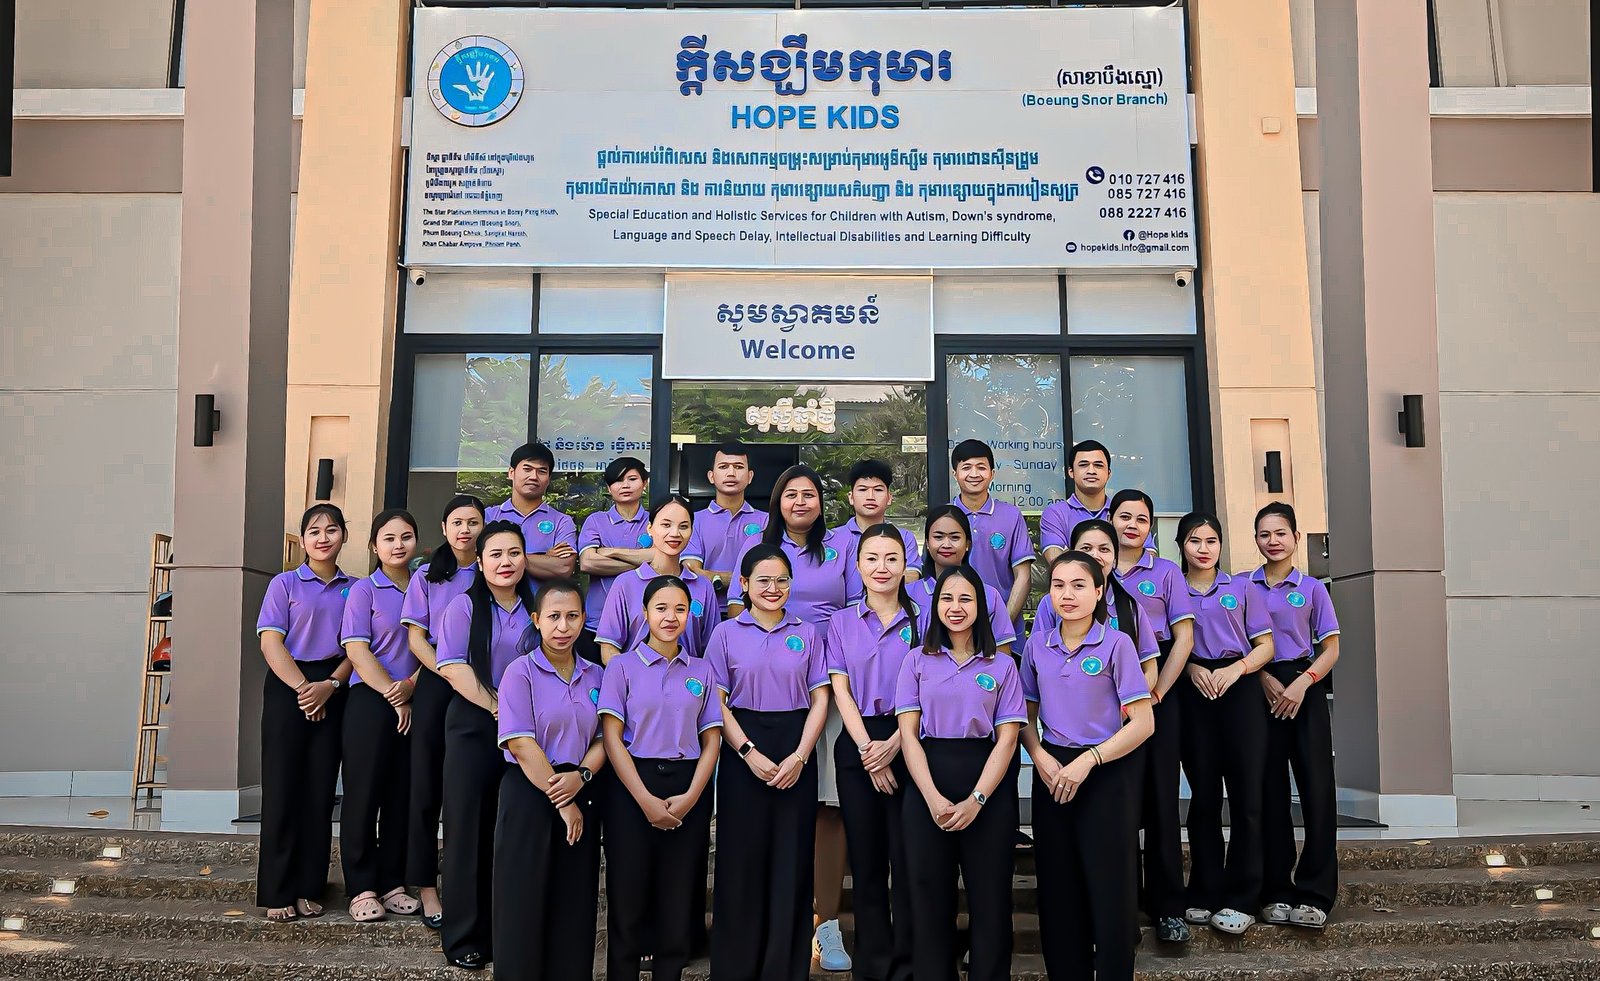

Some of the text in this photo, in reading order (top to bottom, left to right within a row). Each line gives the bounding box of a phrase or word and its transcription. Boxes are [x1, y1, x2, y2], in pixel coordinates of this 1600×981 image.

[1022, 92, 1169, 108] (Boeung Snor Branch)
[731, 104, 901, 130] HOPE KIDS
[1109, 173, 1185, 185] 010 727 416
[680, 179, 700, 196] និង
[704, 179, 767, 197] ការនិយាយ
[895, 179, 914, 197] និង
[1108, 188, 1186, 199] 085 727 416
[588, 208, 1056, 224] Special Education and Holistic Services for Children with Autism, Down's syndrome,
[1099, 207, 1187, 218] 088 2227 416
[422, 219, 440, 227] Grand
[442, 219, 453, 227] Star
[422, 229, 439, 237] Phum
[613, 230, 1032, 244] Language and Speech Delay, Intellectual Disabilities and Learning Difficulty
[1137, 230, 1189, 241] @Hope kids
[716, 294, 880, 332] សូមស្វាគមន៍
[740, 338, 856, 360] Welcome
[987, 440, 1030, 451] Working
[1013, 460, 1058, 471] Sunday
[989, 481, 1032, 494] Morning
[1012, 496, 1045, 507] 12:00
